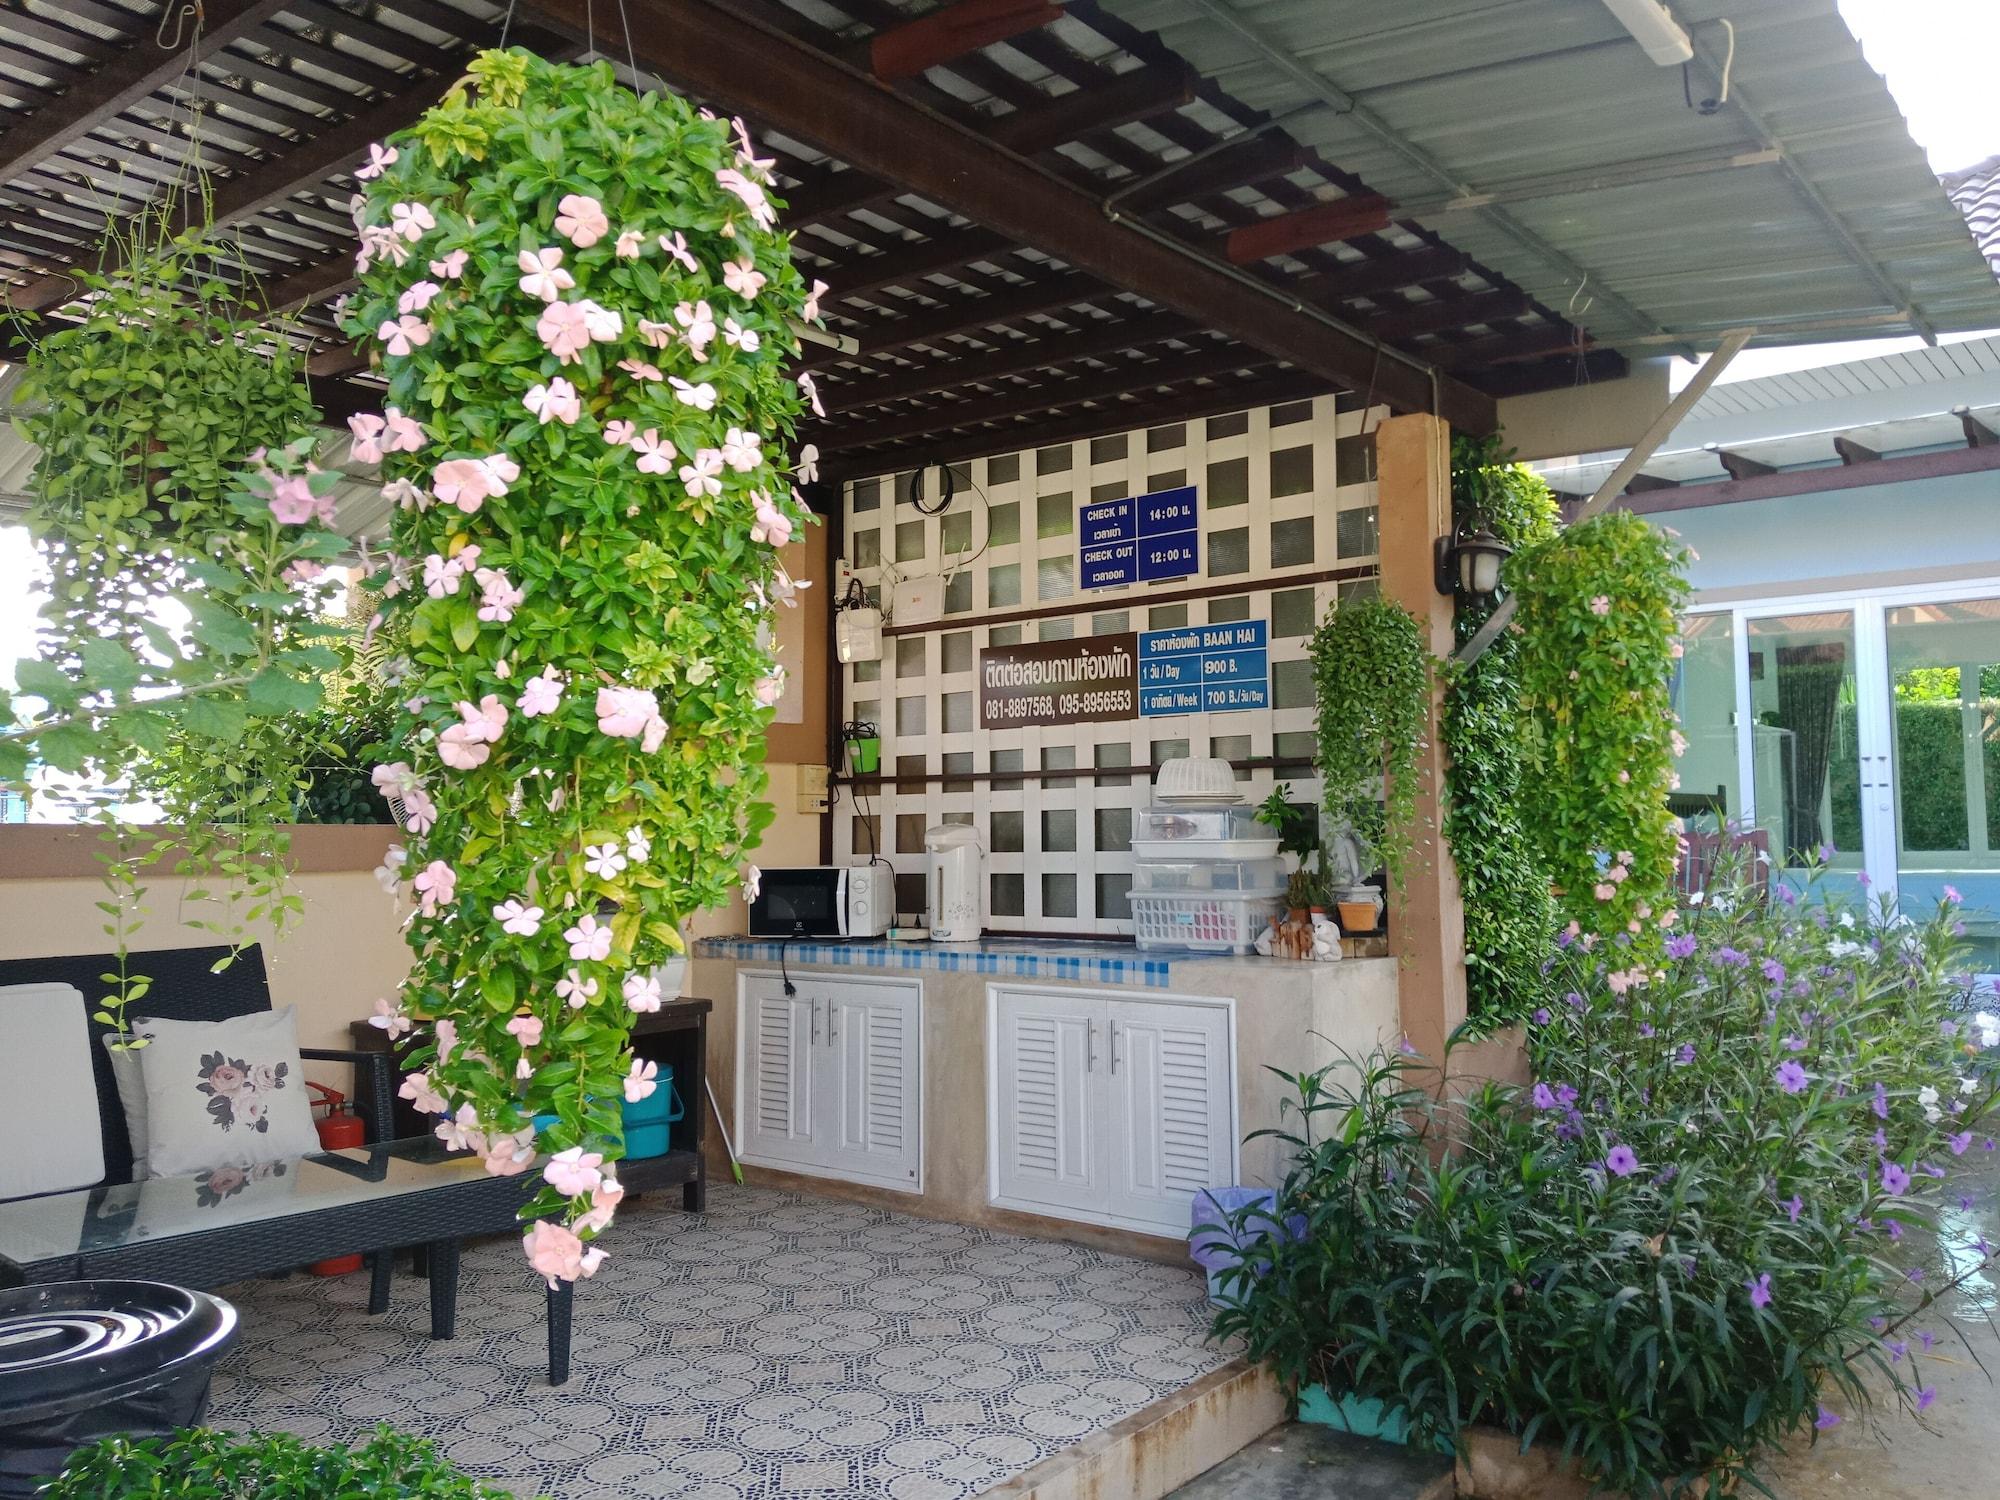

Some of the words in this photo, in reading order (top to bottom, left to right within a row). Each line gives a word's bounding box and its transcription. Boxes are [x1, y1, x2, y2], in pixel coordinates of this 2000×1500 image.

[1087, 507, 1115, 521] CHECK
[1118, 505, 1128, 516] IN
[1150, 506, 1178, 521] 14:00
[1085, 550, 1113, 563] CHECK
[1116, 546, 1133, 558] OUT
[1151, 549, 1179, 564] 12:00
[1093, 569, 1125, 582] เวลาออก
[1151, 632, 1200, 652] ราคาห้องพัก
[1204, 630, 1232, 647] BAAN
[1237, 628, 1255, 643] HAI
[986, 646, 1131, 688] ติดต่อสอบถามห้องพัก
[1143, 666, 1147, 680] 1
[1229, 658, 1238, 673] B.
[985, 696, 1056, 719] 081-8897568,
[1059, 689, 1132, 715] 095-8956553
[1144, 696, 1148, 710] 1
[1207, 690, 1226, 705] 700
